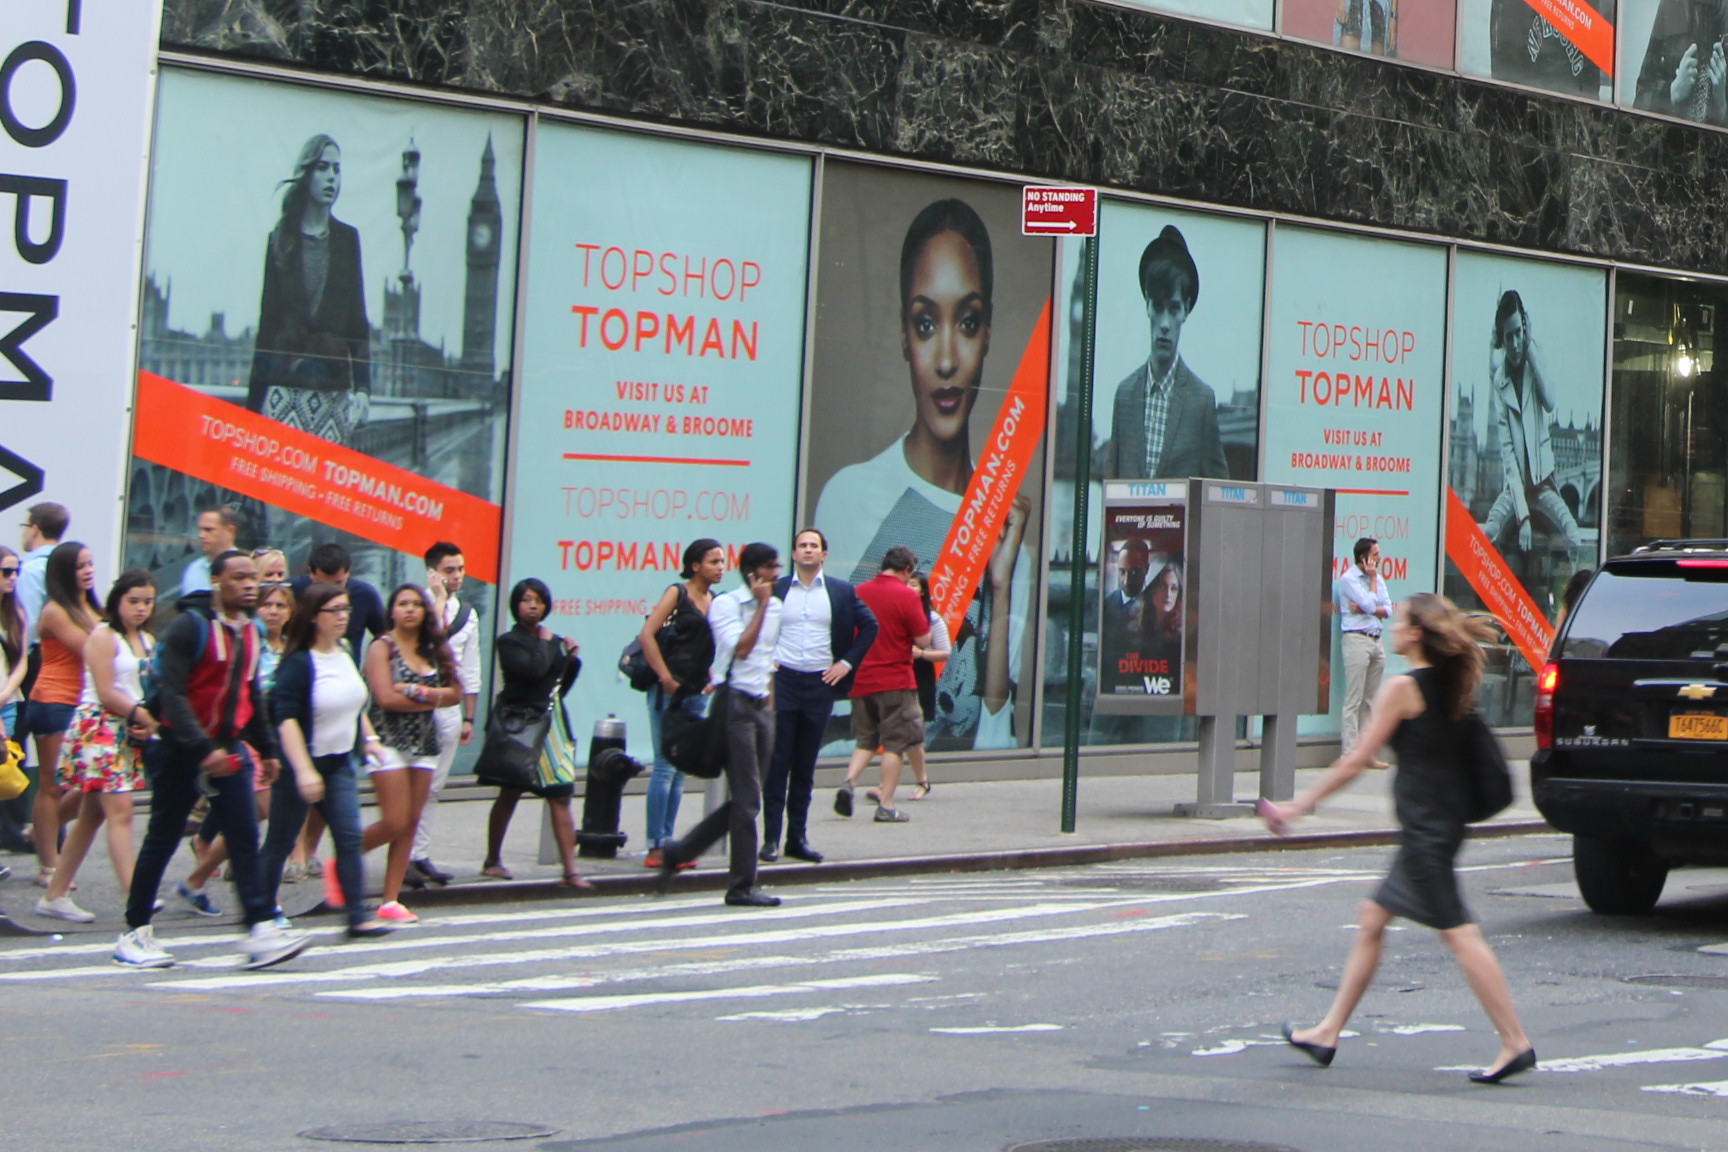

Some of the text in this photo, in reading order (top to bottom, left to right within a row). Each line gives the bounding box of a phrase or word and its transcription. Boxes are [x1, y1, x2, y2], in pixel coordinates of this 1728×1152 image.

[1027, 191, 1086, 203] NO STANDING
[1027, 202, 1065, 214] Anytime
[575, 243, 761, 302] TOPSHOP
[571, 305, 759, 362] TOPMAN
[1297, 321, 1415, 364] TOPSHOP
[616, 381, 709, 405] VISIT US AT
[1295, 370, 1414, 411] TOPMAN
[563, 410, 753, 438] BROADWAY & BROOME
[1323, 429, 1383, 447] VISIT US AT
[200, 415, 444, 521] TOPSHOP.COM TOPMAN.COM
[1291, 453, 1411, 473] BROADWAY & BROOME
[950, 396, 1025, 558] TOPMAN.COM
[230, 456, 404, 531] FREE SHIPPING FREE RETURNS
[1127, 483, 1167, 497] TITAN
[1220, 486, 1246, 501] TITAN
[1282, 491, 1307, 505] TITAN
[560, 486, 750, 521] TOPSHOP.COM
[968, 459, 1017, 565] FREE RETURNS
[1115, 514, 1145, 523] EVERYONE
[1153, 514, 1175, 523] GUILTY
[1146, 521, 1181, 529] SOMETHING
[552, 599, 648, 616] FREE SHIPPING
[1118, 659, 1169, 674] DIVIDE
[1143, 675, 1171, 695] We
[1555, 737, 1630, 747] SUBURBAN
